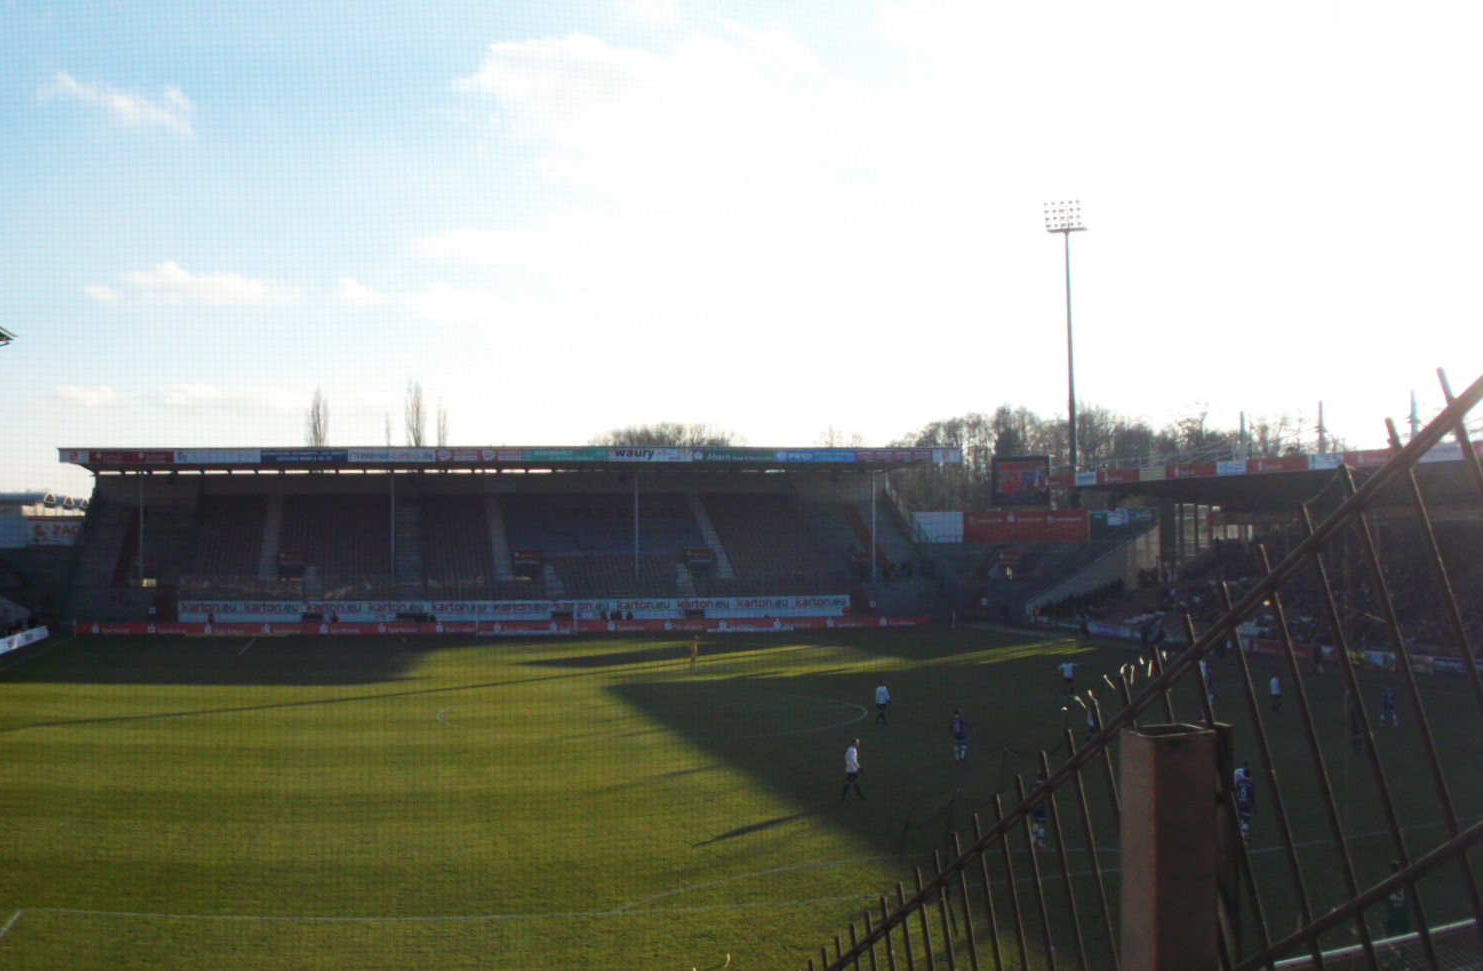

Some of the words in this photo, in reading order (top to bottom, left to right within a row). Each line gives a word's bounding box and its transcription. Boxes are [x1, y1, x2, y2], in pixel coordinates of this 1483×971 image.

[615, 449, 655, 461] waury
[306, 602, 362, 612] karton.eu
[368, 602, 424, 612] karton.eu
[493, 601, 549, 612] karton.eu
[617, 600, 670, 610] karton.eu
[677, 599, 730, 609] karton.eu
[736, 598, 789, 608] karton.eu
[795, 597, 846, 607] karton.eu
[181, 602, 237, 613] karton.eu
[244, 602, 299, 613] karton.eu
